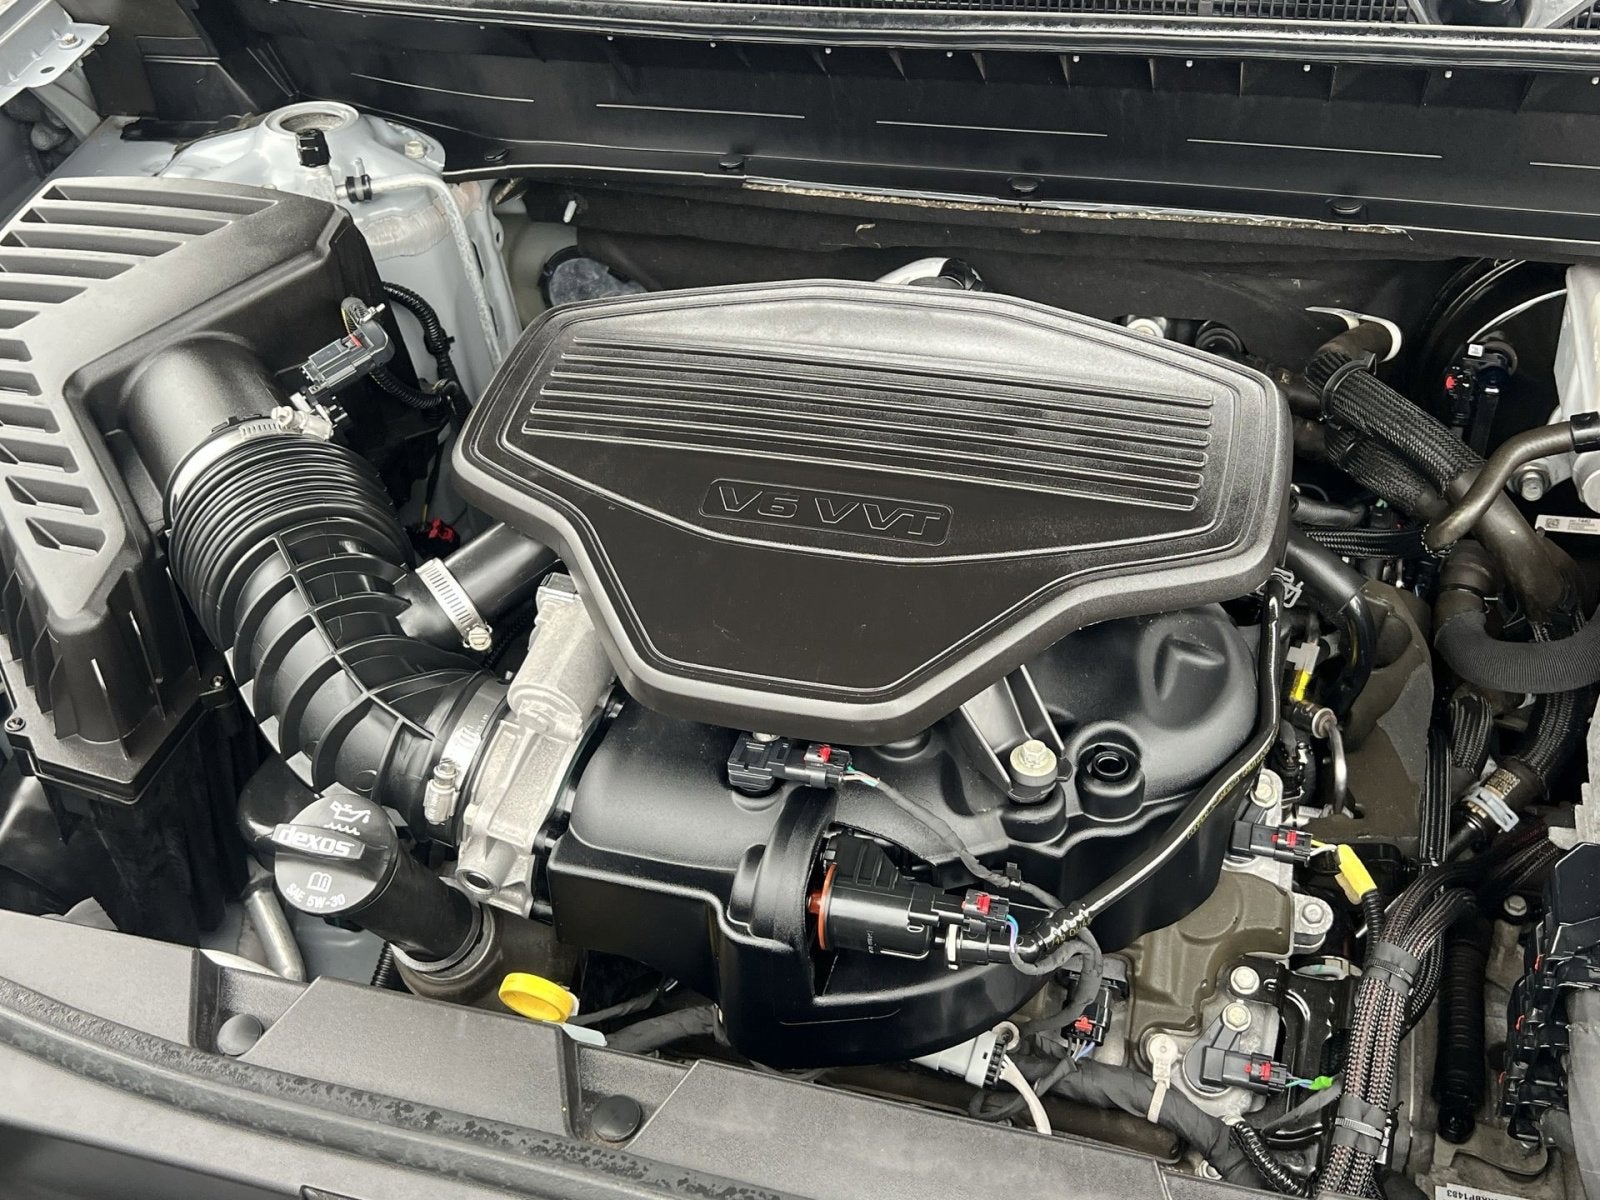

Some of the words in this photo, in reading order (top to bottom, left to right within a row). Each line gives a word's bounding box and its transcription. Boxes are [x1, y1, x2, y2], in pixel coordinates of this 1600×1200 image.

[718, 485, 799, 518] V6
[814, 496, 945, 536] VVT
[279, 827, 355, 857] dexos
[286, 883, 305, 902] SAE
[307, 894, 345, 908] 5W-30
